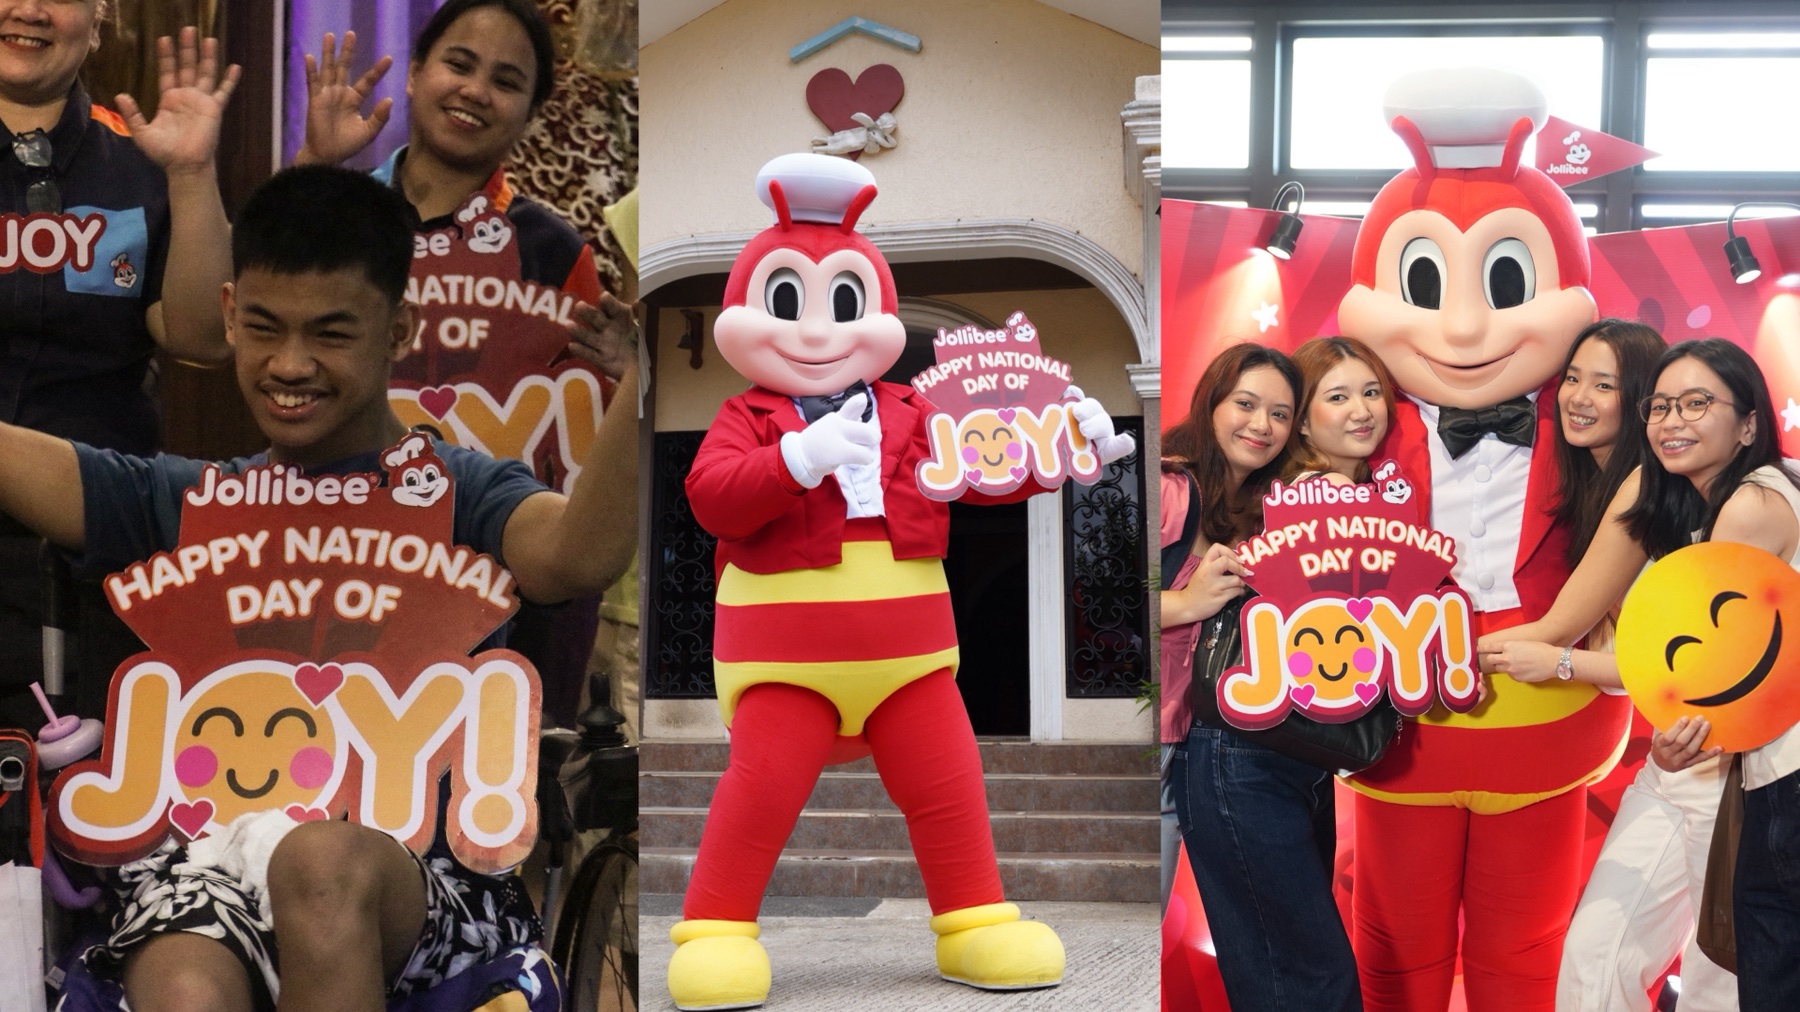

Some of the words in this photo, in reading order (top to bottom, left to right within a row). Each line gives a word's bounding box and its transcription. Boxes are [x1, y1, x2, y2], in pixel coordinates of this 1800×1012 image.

[1546, 163, 1588, 174] Jollibee
[0, 218, 102, 268] JOY
[438, 316, 491, 349] OF
[935, 327, 1007, 347] Jollibee
[914, 354, 973, 393] HAPPY
[978, 350, 1071, 382] NATIONAL
[962, 373, 999, 396] DAY
[1003, 372, 1029, 391] OF
[186, 464, 370, 506] Jollibee
[1265, 480, 1371, 506] Jollibee
[1326, 515, 1455, 563] NATIONAL
[108, 529, 269, 611] HAPPY
[284, 525, 513, 609] NATIONAL
[1299, 547, 1354, 578] DAY
[1360, 547, 1397, 572] OF
[226, 578, 324, 625] DAY
[333, 579, 402, 622] OF
[1223, 591, 1471, 715] JOY!
